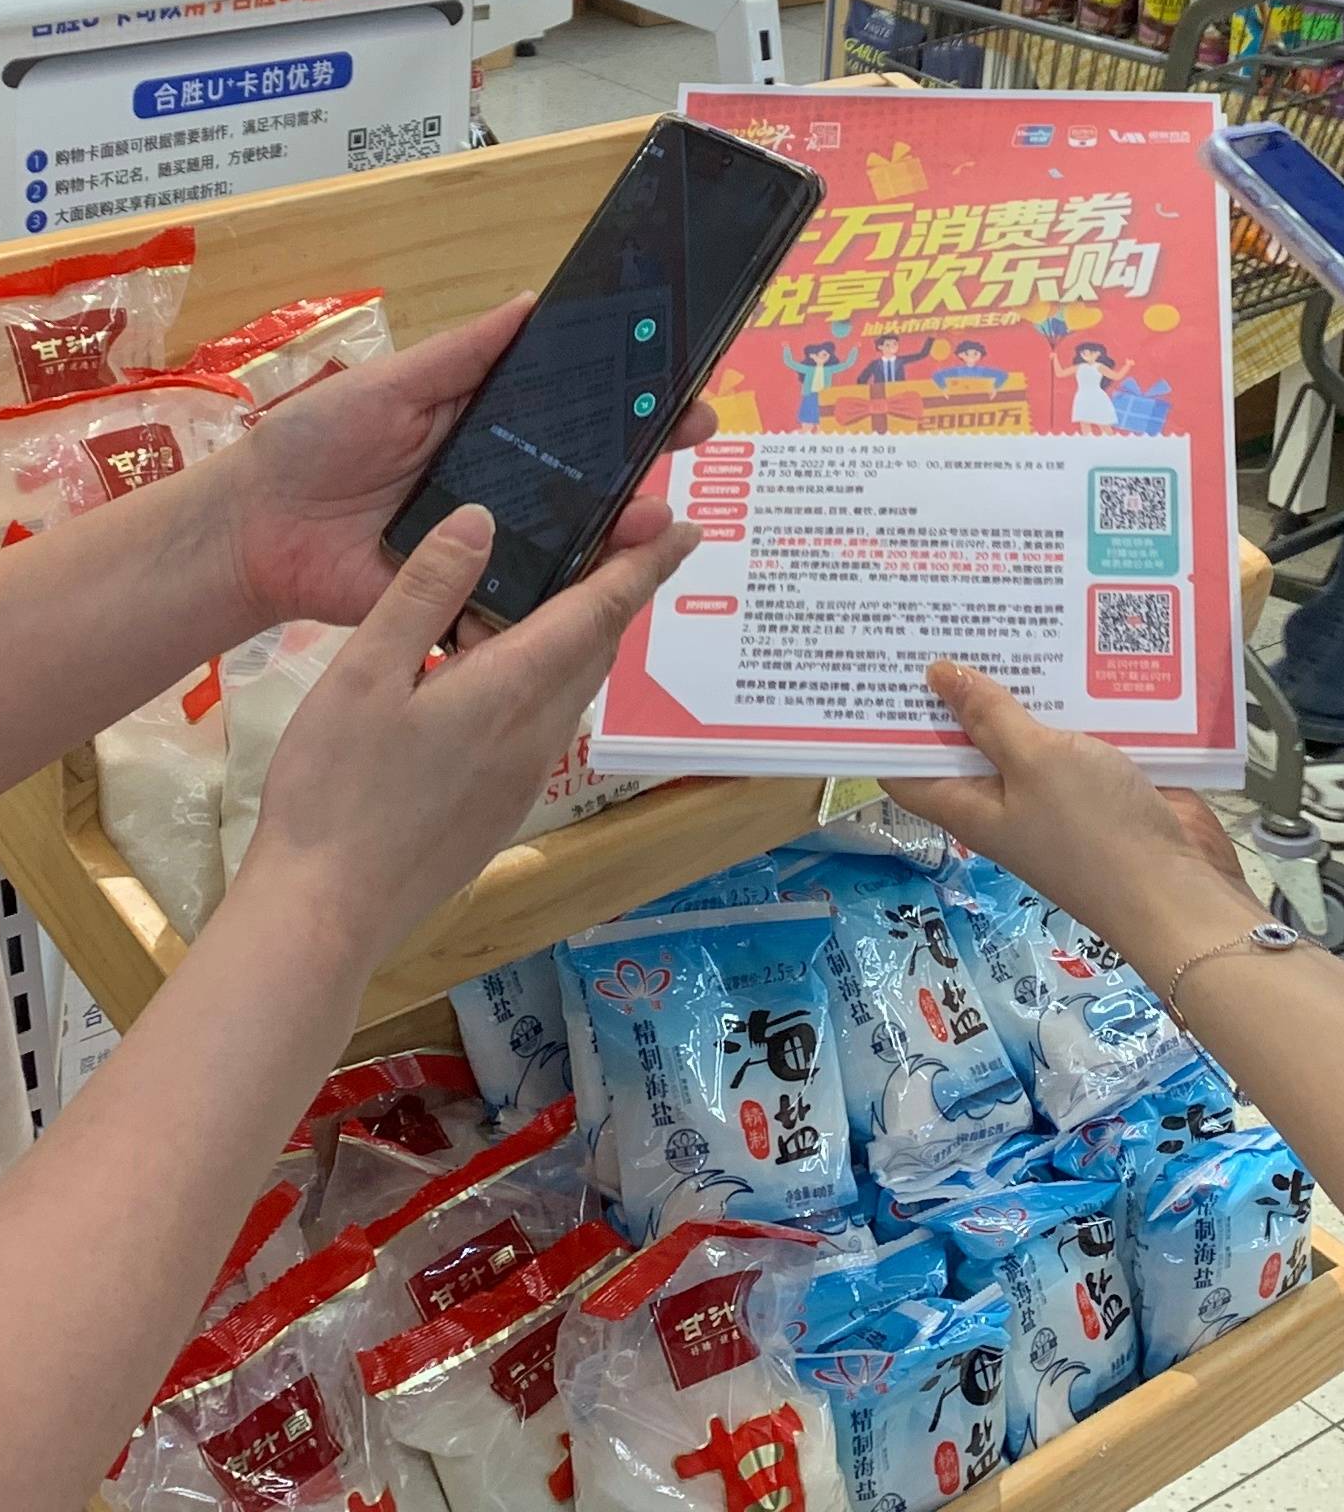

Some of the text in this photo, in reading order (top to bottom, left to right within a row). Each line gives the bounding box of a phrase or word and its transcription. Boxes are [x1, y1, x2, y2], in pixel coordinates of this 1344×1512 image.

[631, 1019, 676, 1128] 精制海盐
[713, 1008, 822, 1166] 海盐
[680, 1300, 737, 1343] 甘汁
[849, 1407, 878, 1502] 精制海盐
